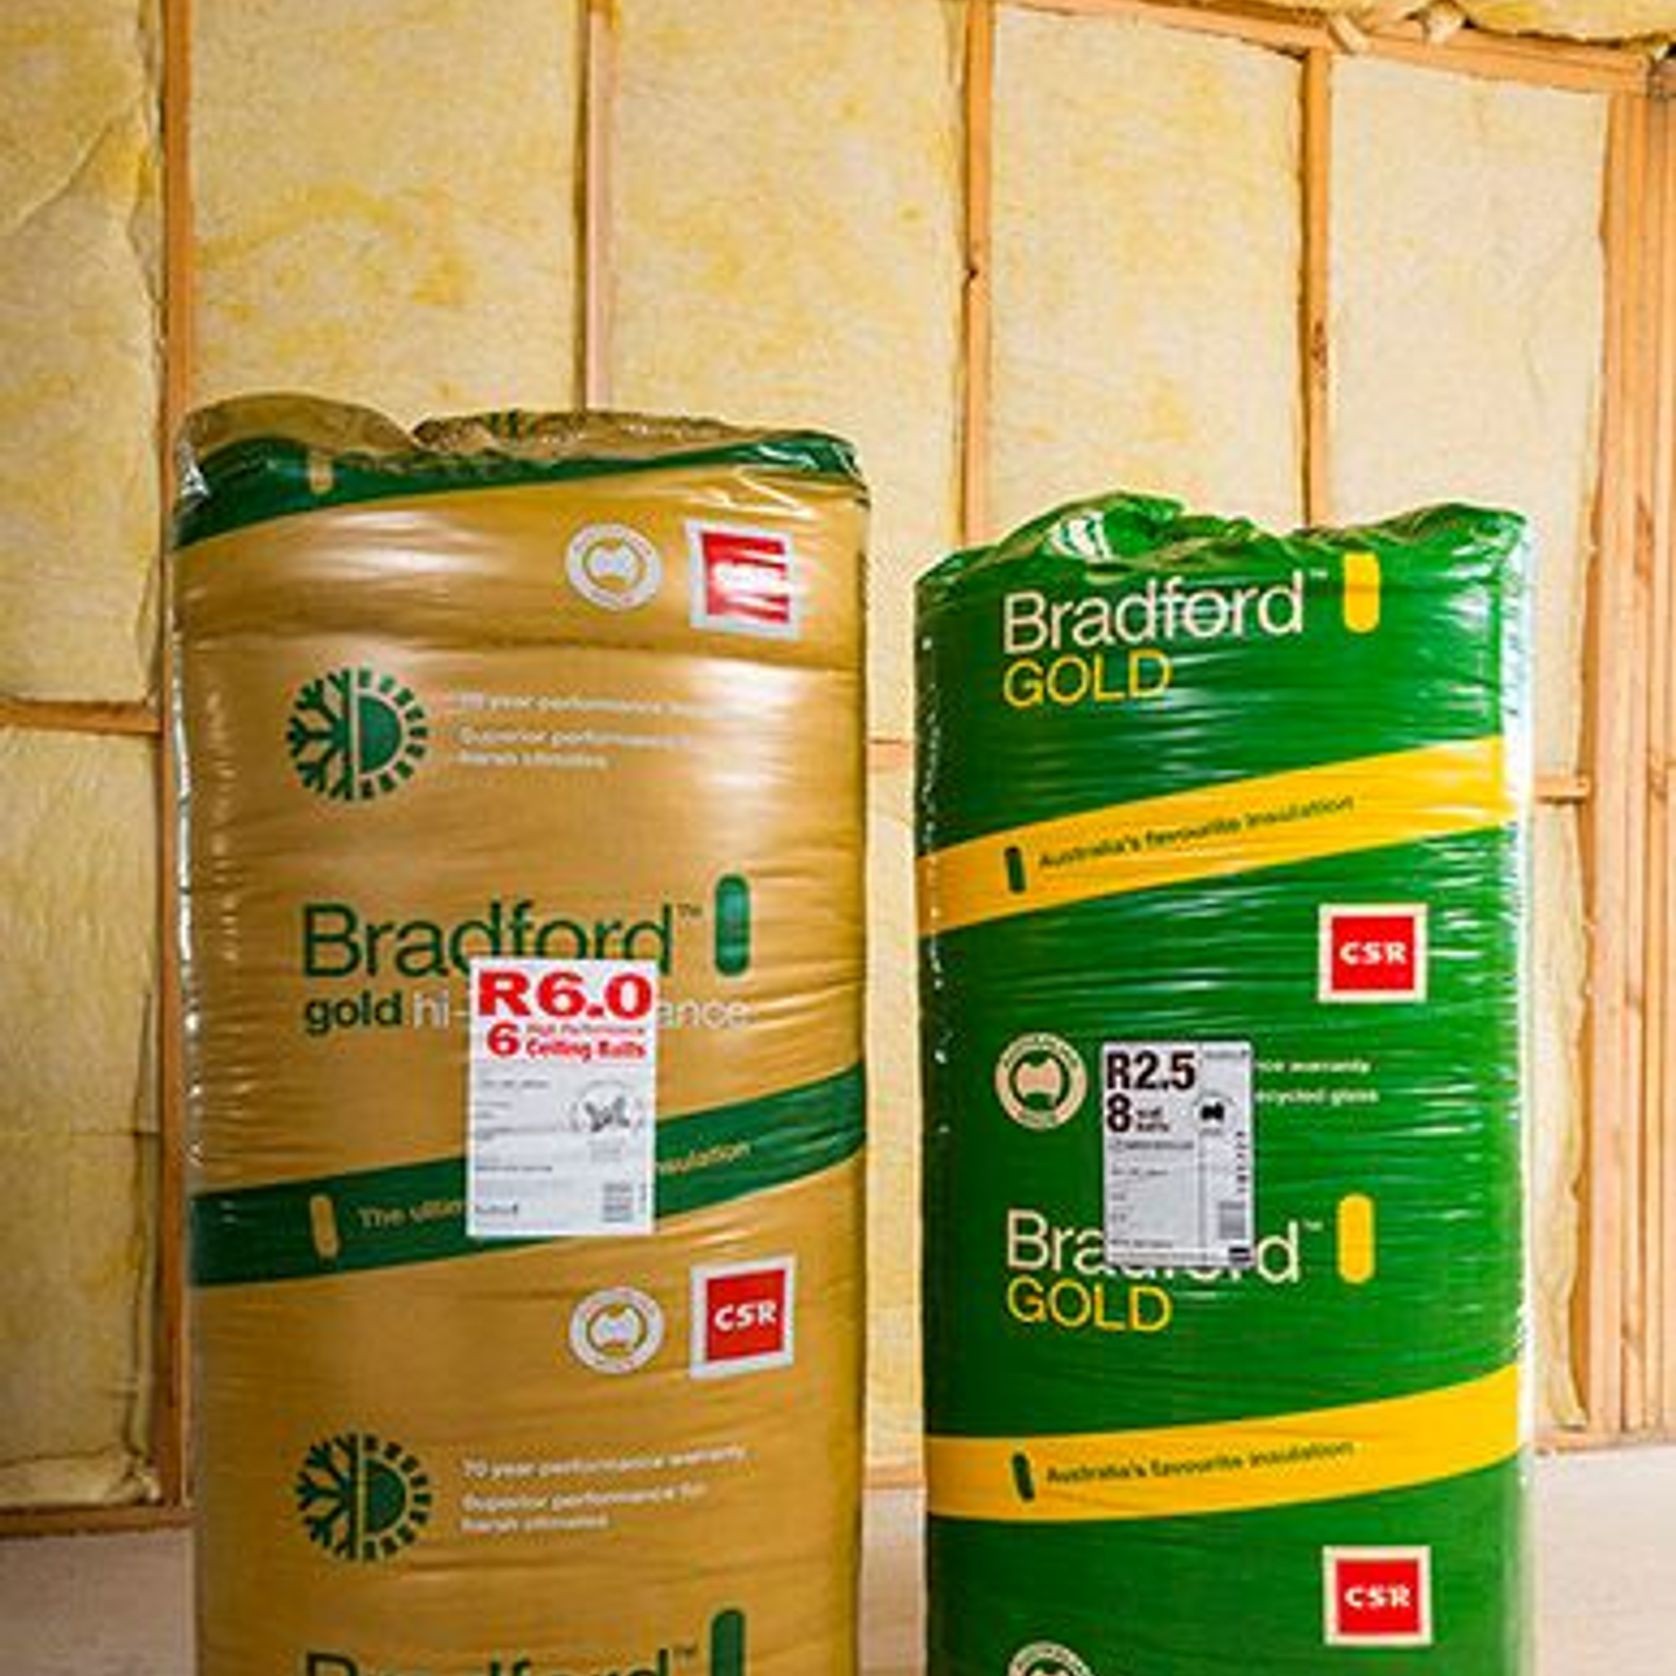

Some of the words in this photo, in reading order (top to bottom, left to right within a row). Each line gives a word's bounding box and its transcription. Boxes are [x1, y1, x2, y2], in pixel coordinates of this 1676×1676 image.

[1004, 570, 1304, 654] Bradford
[1003, 649, 1173, 708] GOLD
[1244, 797, 1355, 828] insulation
[303, 901, 671, 977] Bradford
[1339, 941, 1407, 965] CSR
[304, 990, 402, 1035] gold
[477, 969, 653, 1021] R6.0
[487, 1020, 520, 1058] 6
[1106, 1050, 1196, 1091] R2.5
[1106, 1092, 1131, 1133] 8
[656, 1140, 752, 1175] nsulation
[714, 1301, 778, 1332] CSR
[1007, 1275, 1172, 1332] GOLD
[1344, 1584, 1412, 1609] CSR
